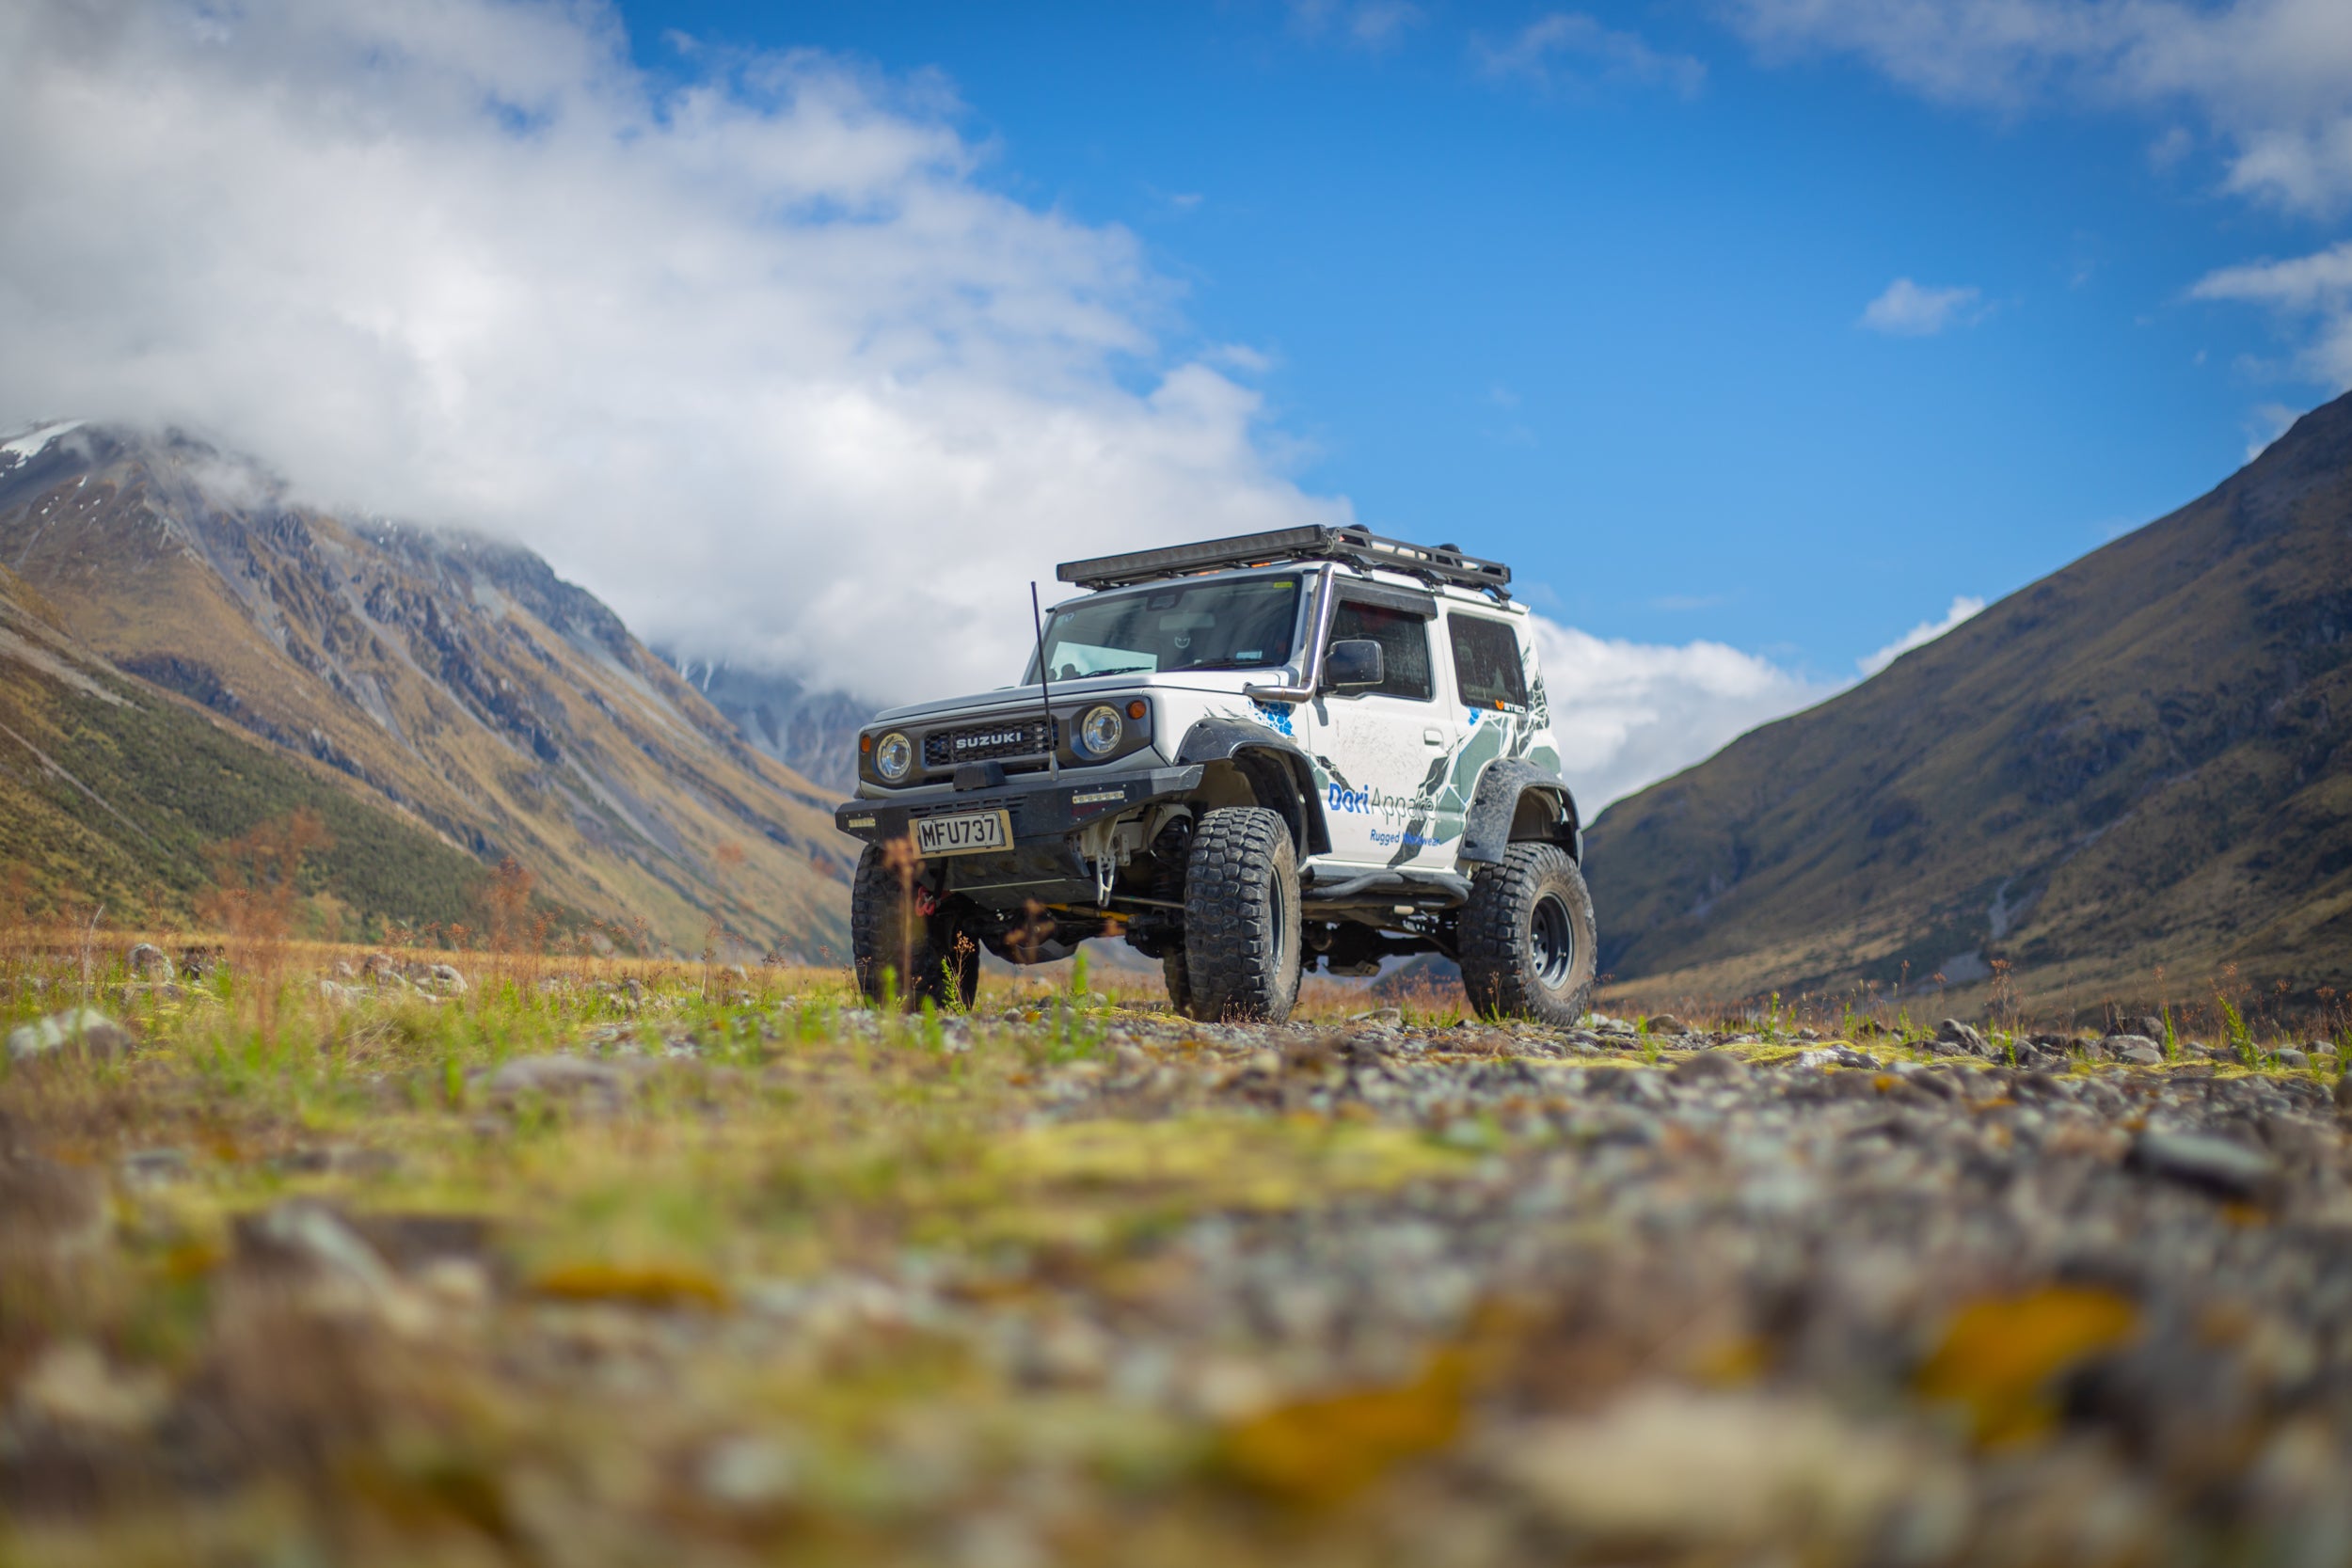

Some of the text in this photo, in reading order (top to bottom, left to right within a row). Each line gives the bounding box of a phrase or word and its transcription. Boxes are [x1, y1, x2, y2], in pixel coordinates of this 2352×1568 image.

[956, 732, 1022, 749] SUZUKI
[921, 818, 994, 847] MFU737
[1370, 829, 1401, 846] Rugged
